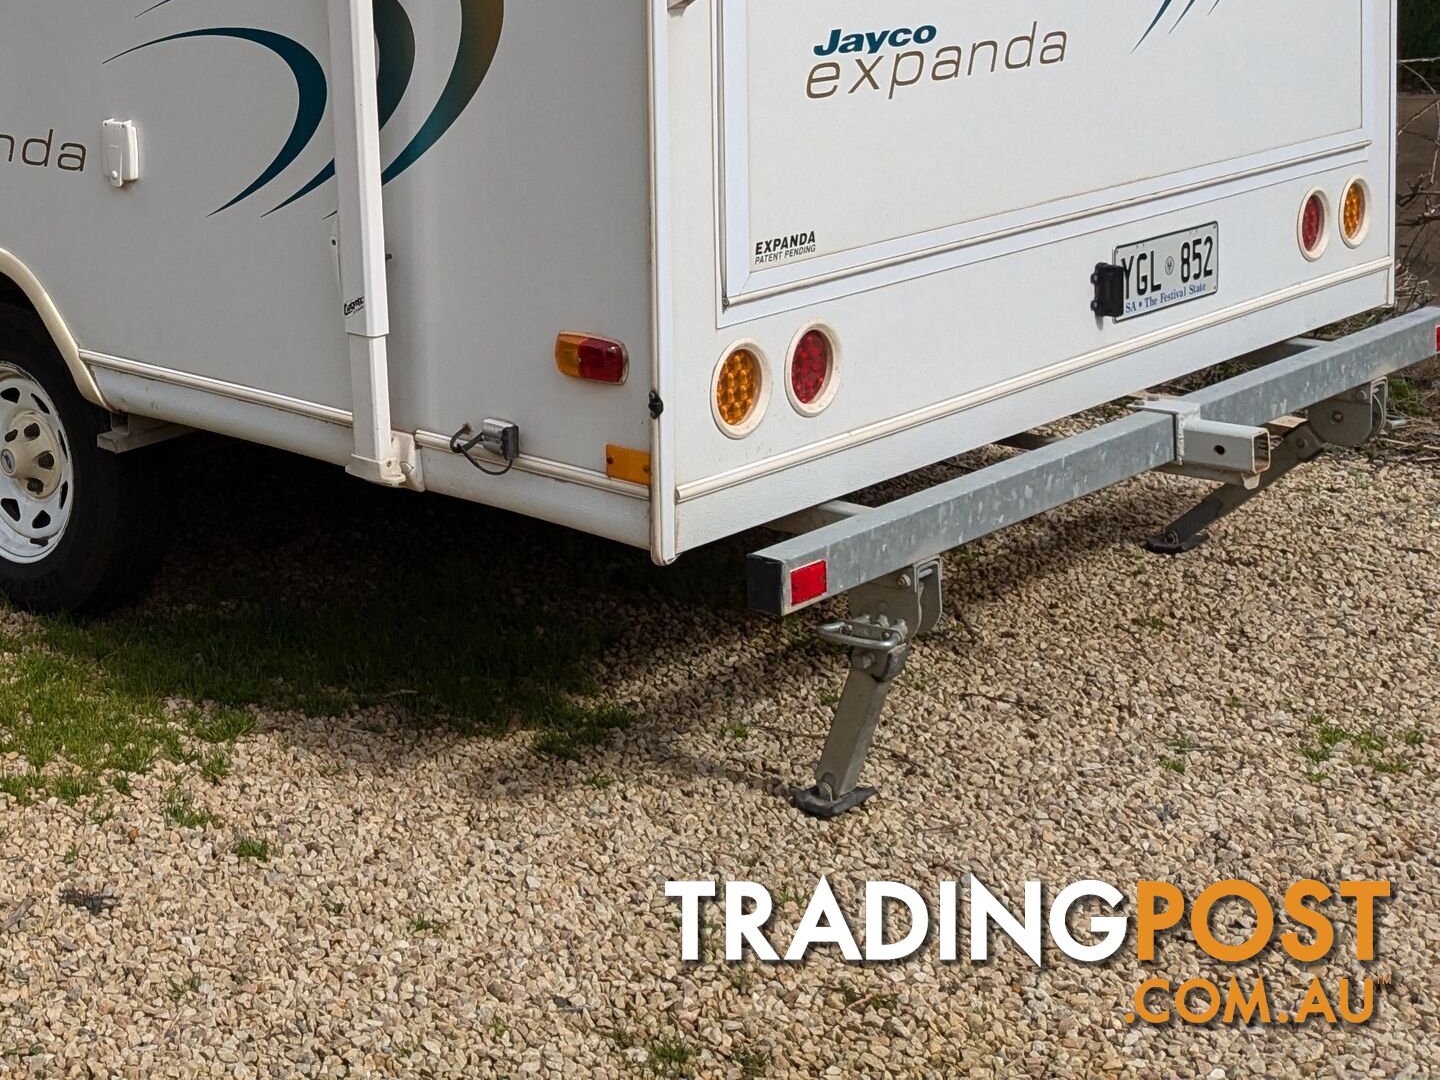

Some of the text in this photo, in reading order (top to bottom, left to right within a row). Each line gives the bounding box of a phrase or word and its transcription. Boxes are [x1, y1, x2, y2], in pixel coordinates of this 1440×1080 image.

[813, 25, 937, 56] Jayco
[806, 21, 1067, 100] expanda
[754, 245, 816, 265] PATENT PENDING
[755, 231, 816, 255] EXPANDA
[1121, 235, 1213, 300] YGL 852
[1125, 282, 1207, 313] SA The Festival State
